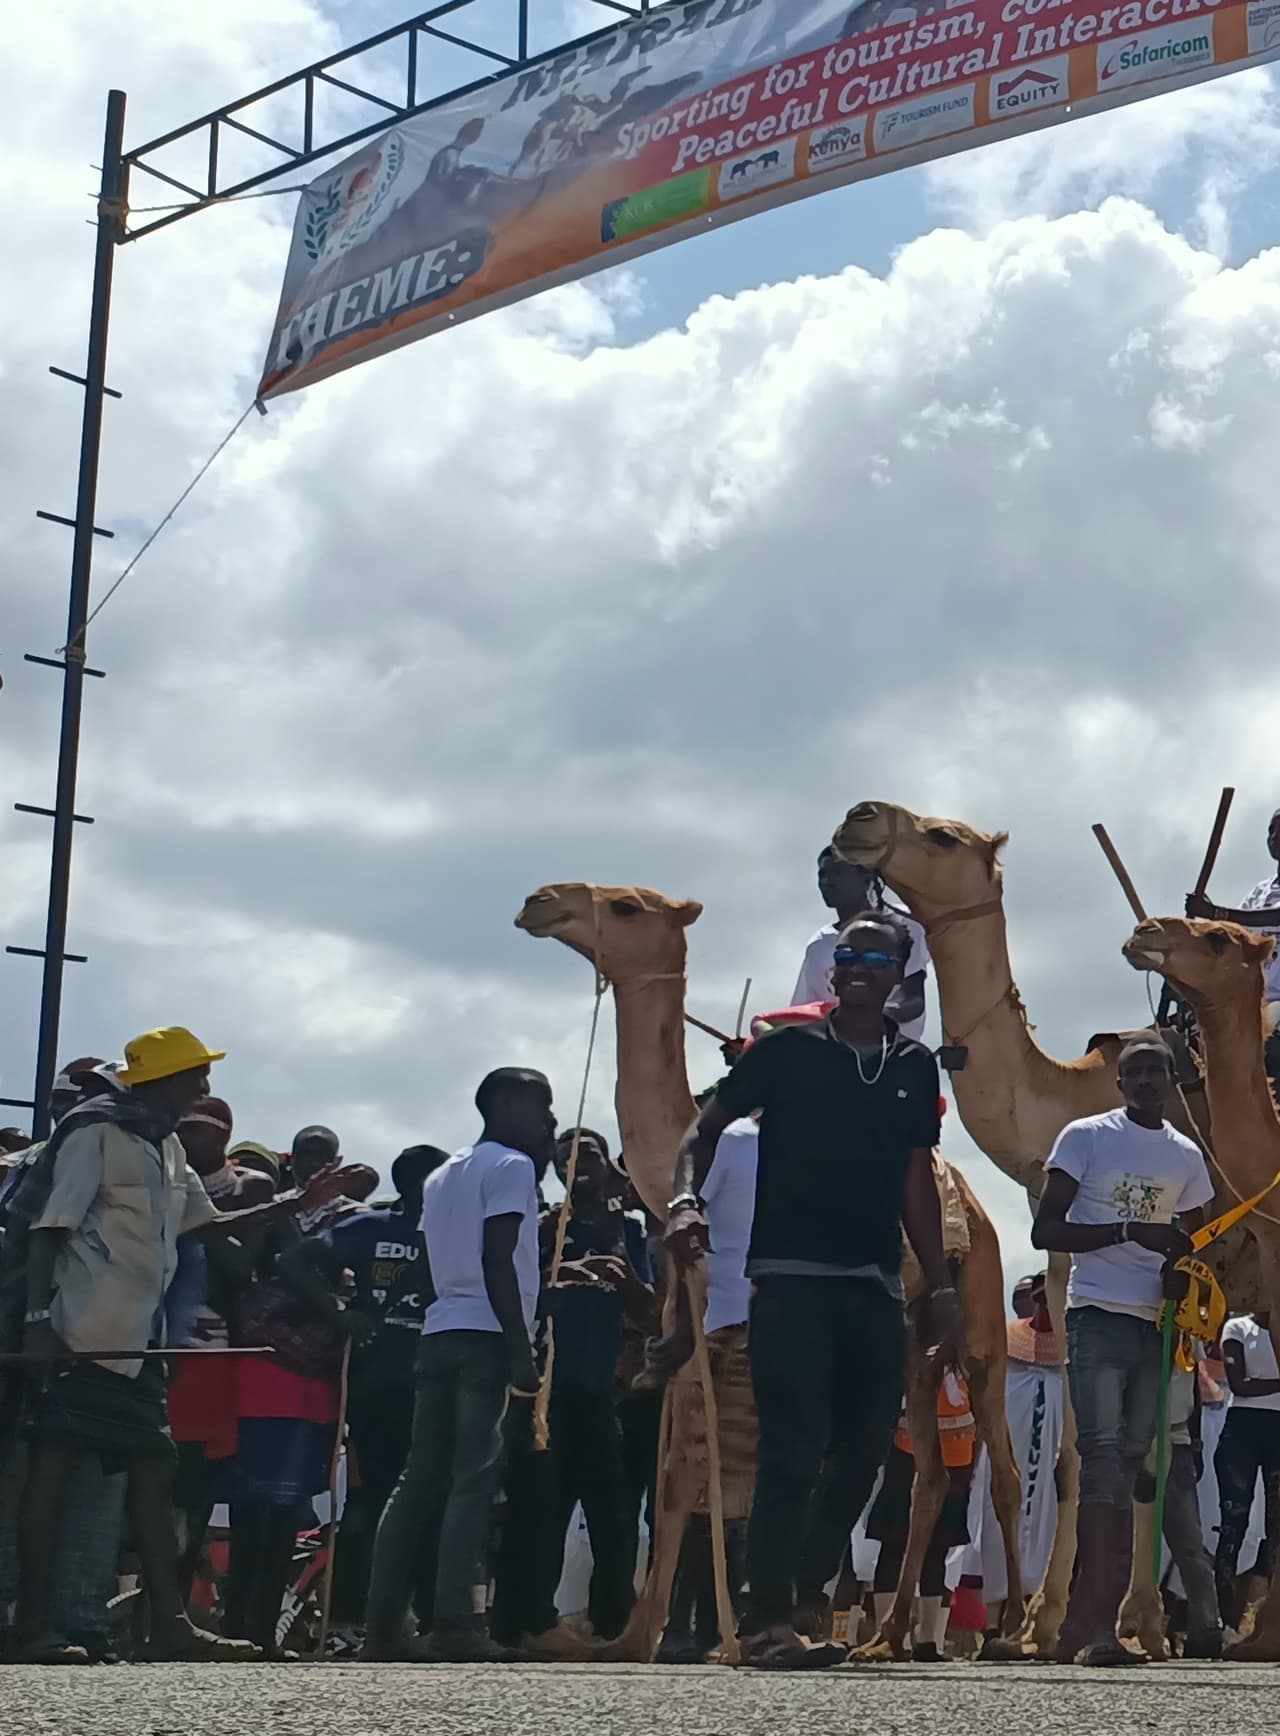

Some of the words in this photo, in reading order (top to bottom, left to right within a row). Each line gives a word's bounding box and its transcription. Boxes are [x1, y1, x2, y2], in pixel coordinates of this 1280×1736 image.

[1120, 35, 1209, 70] Safaricom
[613, 80, 755, 160] Sporting
[761, 63, 814, 101] for
[822, 11, 985, 80] tourism,
[997, 83, 1060, 110] EQUITY
[672, 88, 828, 173] Peaceful
[838, 32, 1004, 113] Cultural
[942, 97, 969, 112] FUND
[808, 133, 861, 159] Kenya
[275, 240, 472, 371] THEME:
[374, 1241, 420, 1261] EDU
